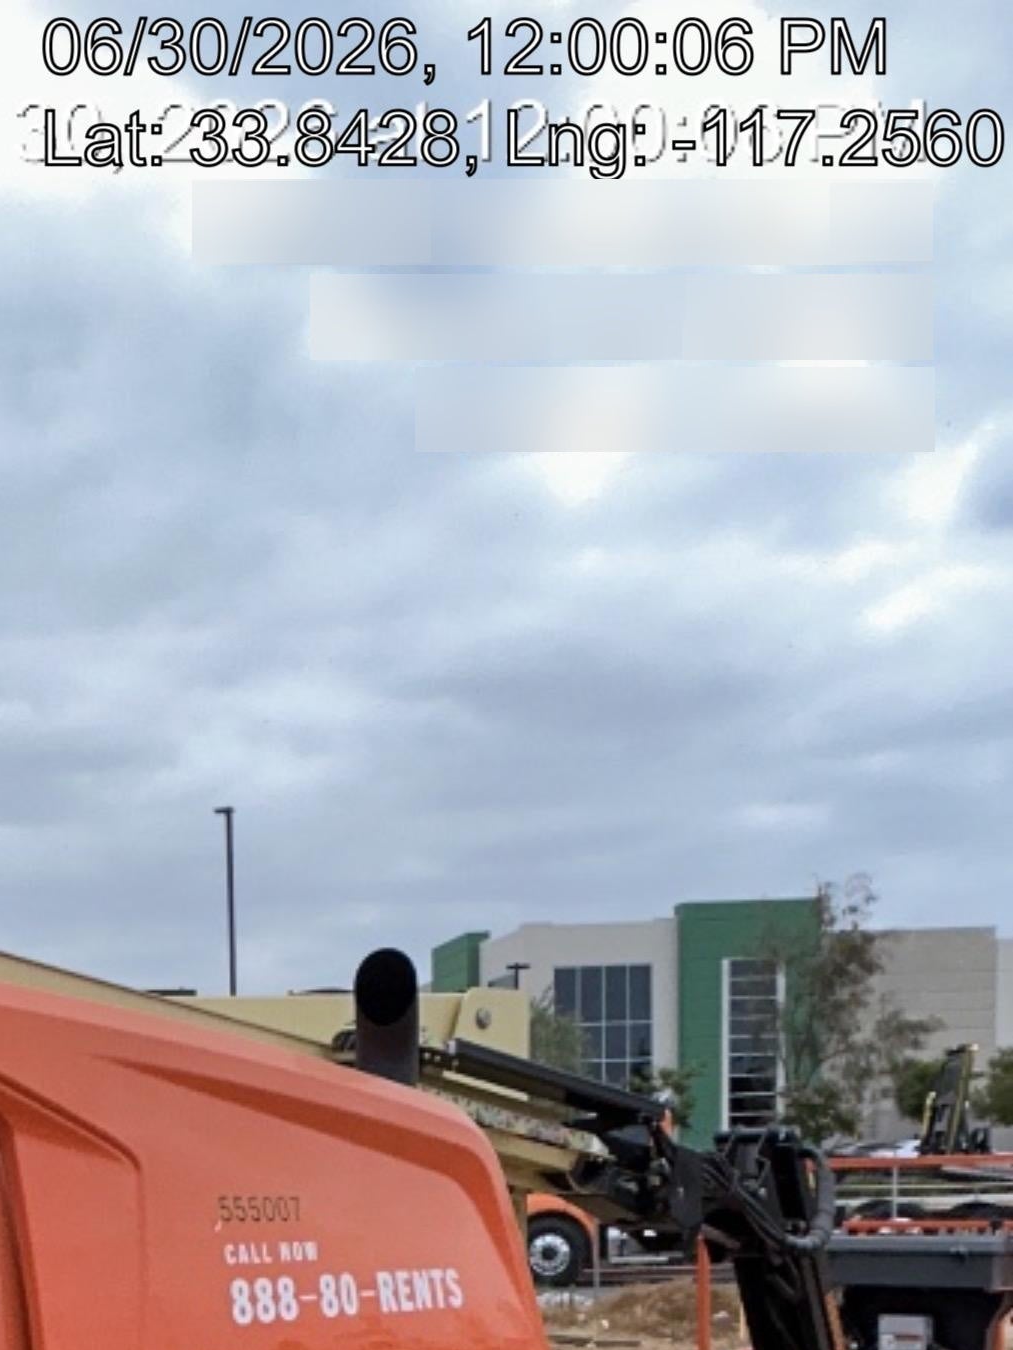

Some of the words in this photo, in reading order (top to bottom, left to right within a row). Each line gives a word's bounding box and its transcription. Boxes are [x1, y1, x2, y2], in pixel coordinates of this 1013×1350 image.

[217, 1196, 302, 1223] 555007
[223, 1243, 274, 1265] CALL
[278, 1240, 319, 1263] NOW
[229, 1267, 465, 1326] 888-80-RENTS
